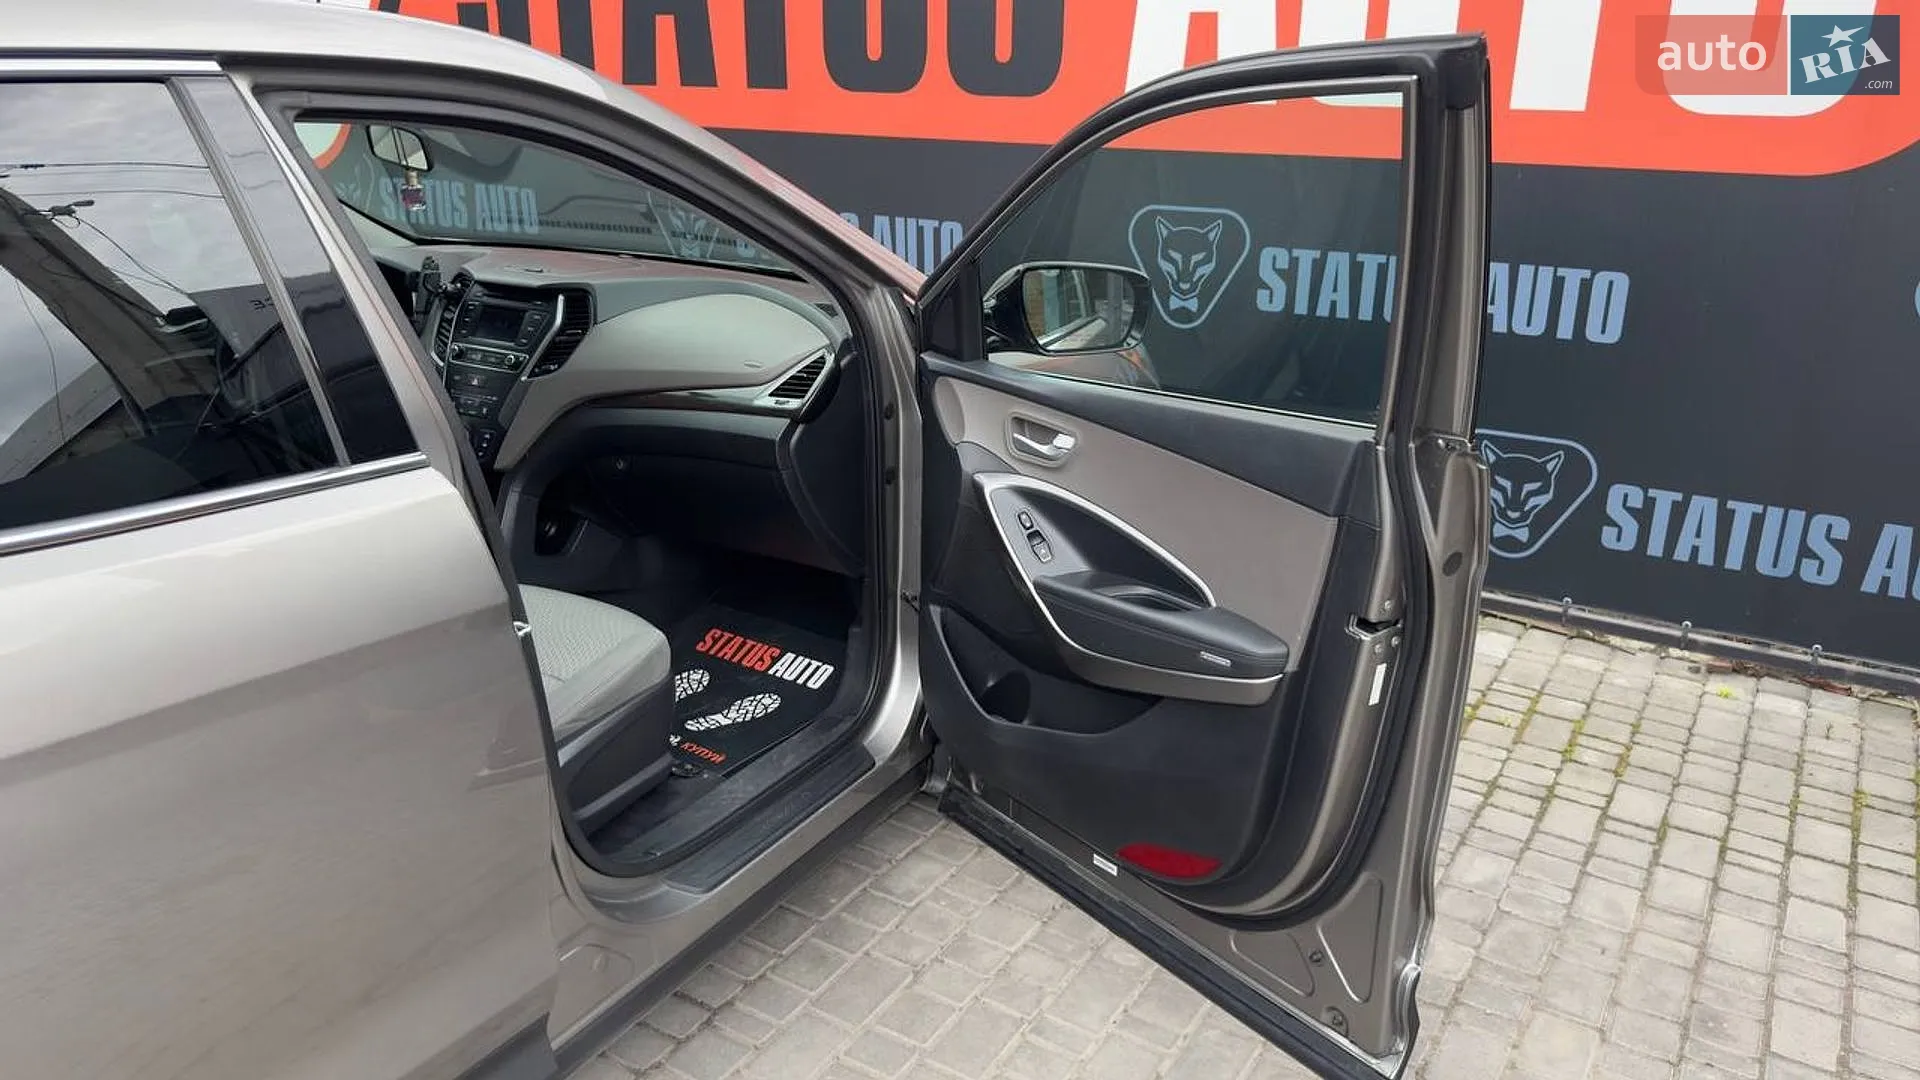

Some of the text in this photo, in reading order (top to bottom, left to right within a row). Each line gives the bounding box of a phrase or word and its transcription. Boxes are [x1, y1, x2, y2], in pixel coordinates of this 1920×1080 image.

[474, 182, 539, 235] AUTO
[1486, 261, 1630, 345] AUTO
[1600, 483, 1920, 601] STATUS A
